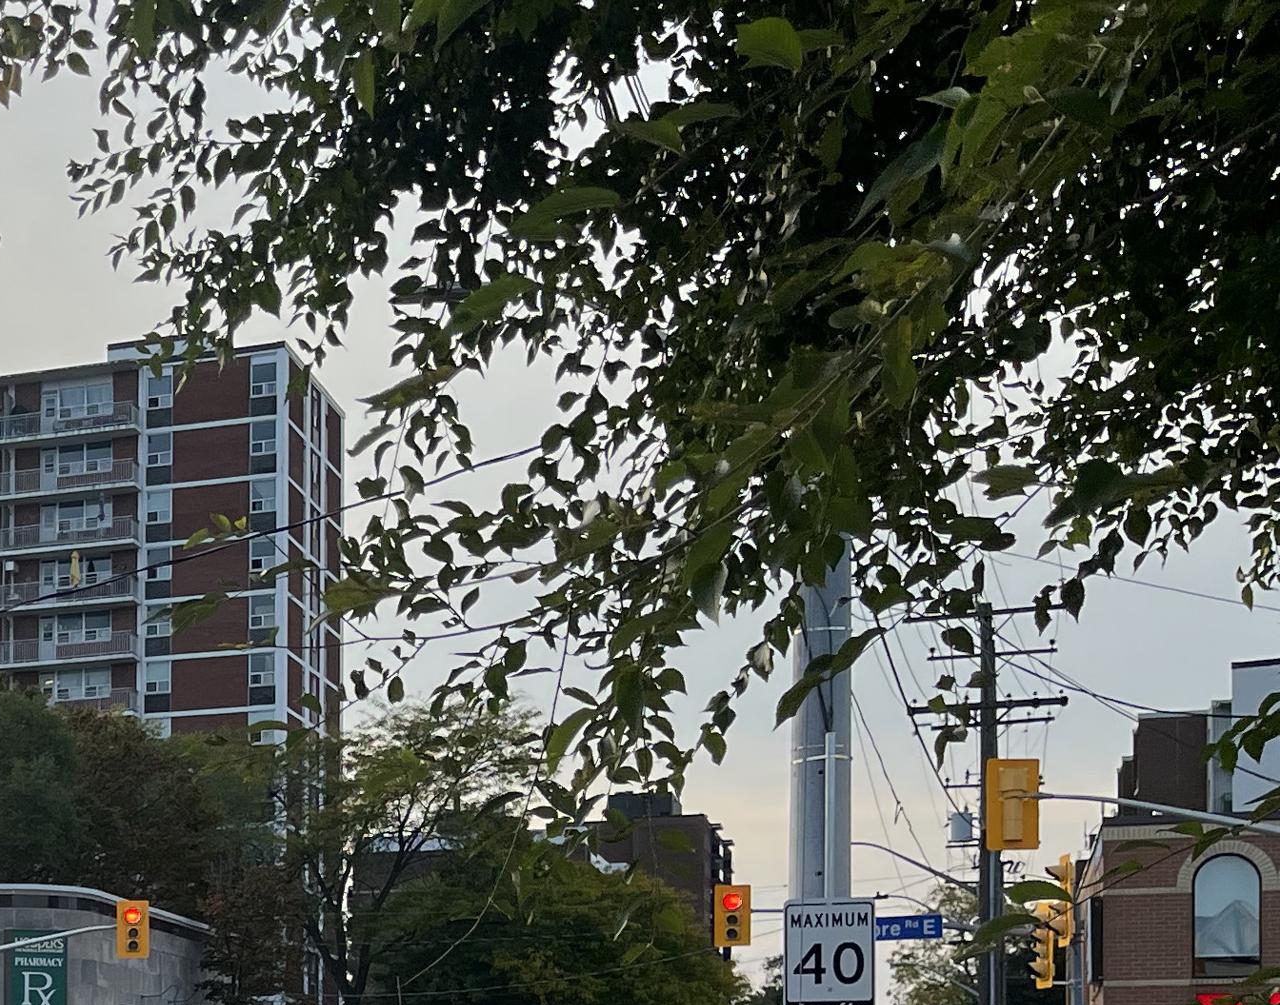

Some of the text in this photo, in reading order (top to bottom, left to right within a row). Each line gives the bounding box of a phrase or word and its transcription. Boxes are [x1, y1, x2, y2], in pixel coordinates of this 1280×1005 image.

[790, 912, 869, 928] MAXIMUM
[905, 920, 919, 928] Rd
[923, 919, 936, 935] E
[14, 957, 64, 967] PHARMACY
[793, 942, 865, 985] 40
